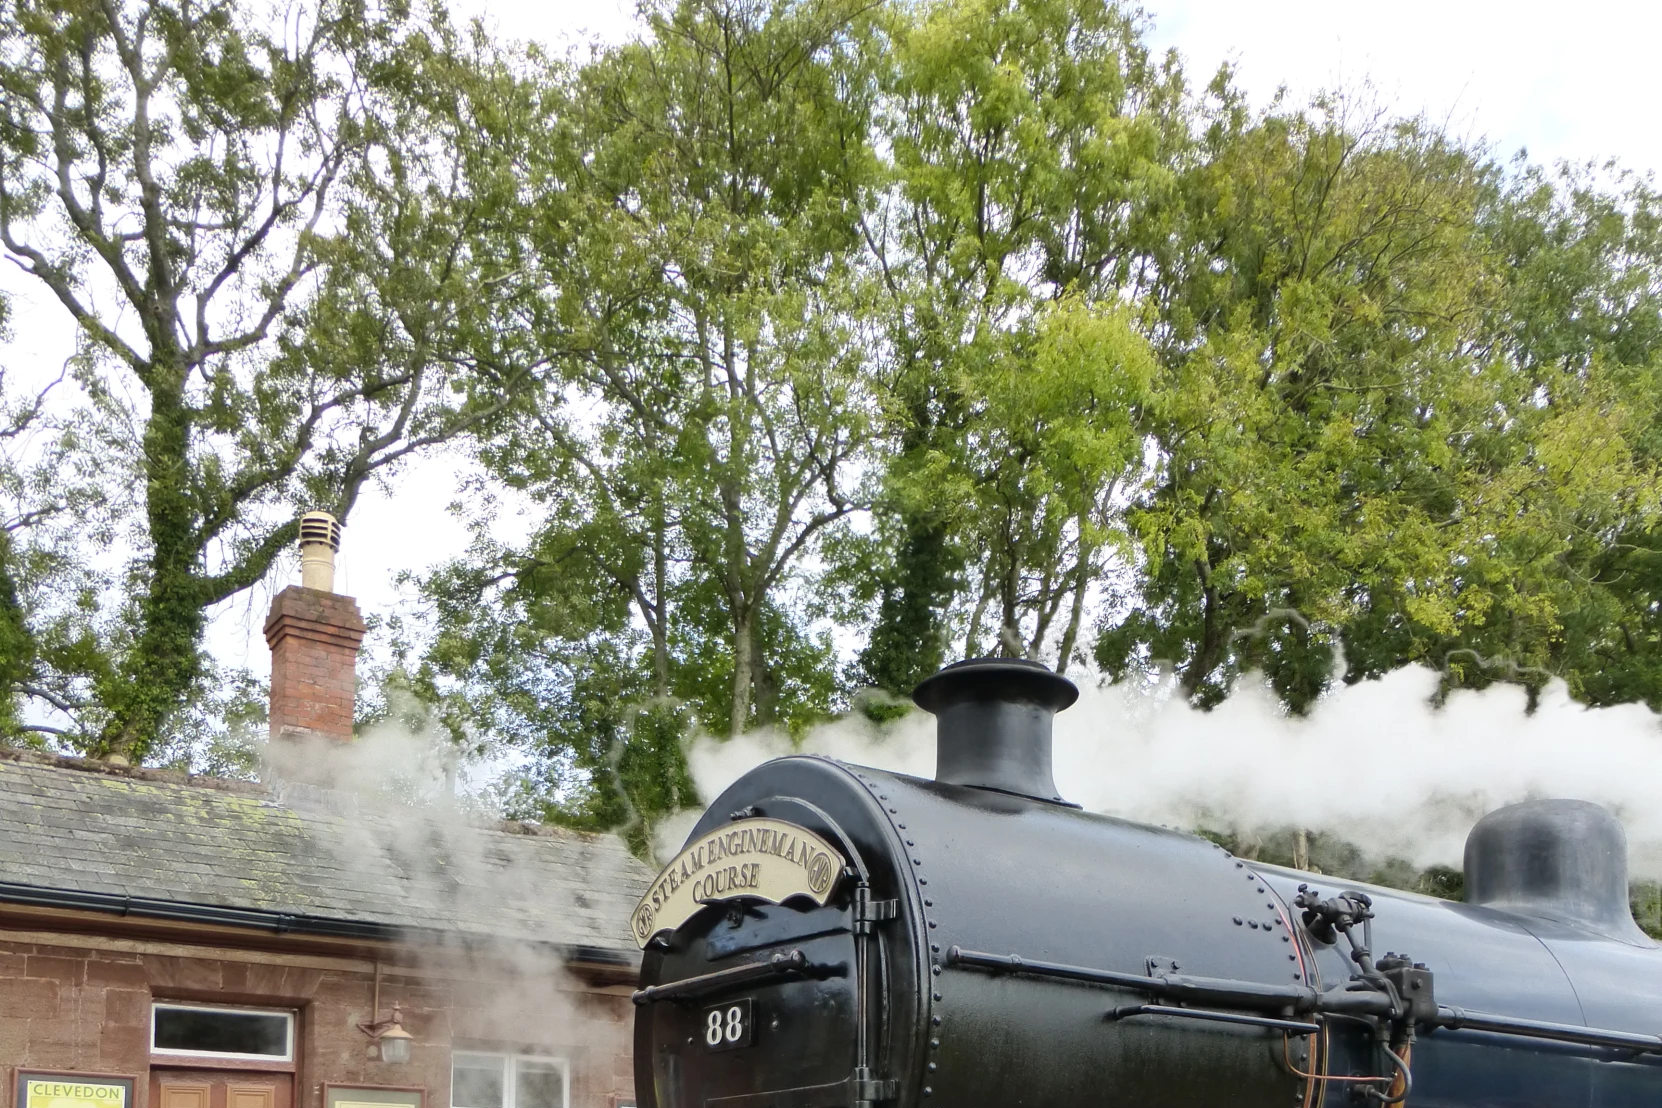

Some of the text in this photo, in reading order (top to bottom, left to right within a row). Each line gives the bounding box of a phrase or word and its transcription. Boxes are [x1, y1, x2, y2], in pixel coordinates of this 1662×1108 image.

[652, 828, 816, 910] STEAM ENGINEMAN
[692, 863, 761, 904] COURSE
[706, 1006, 743, 1046] 88
[33, 1083, 120, 1100] CLEVEDON
